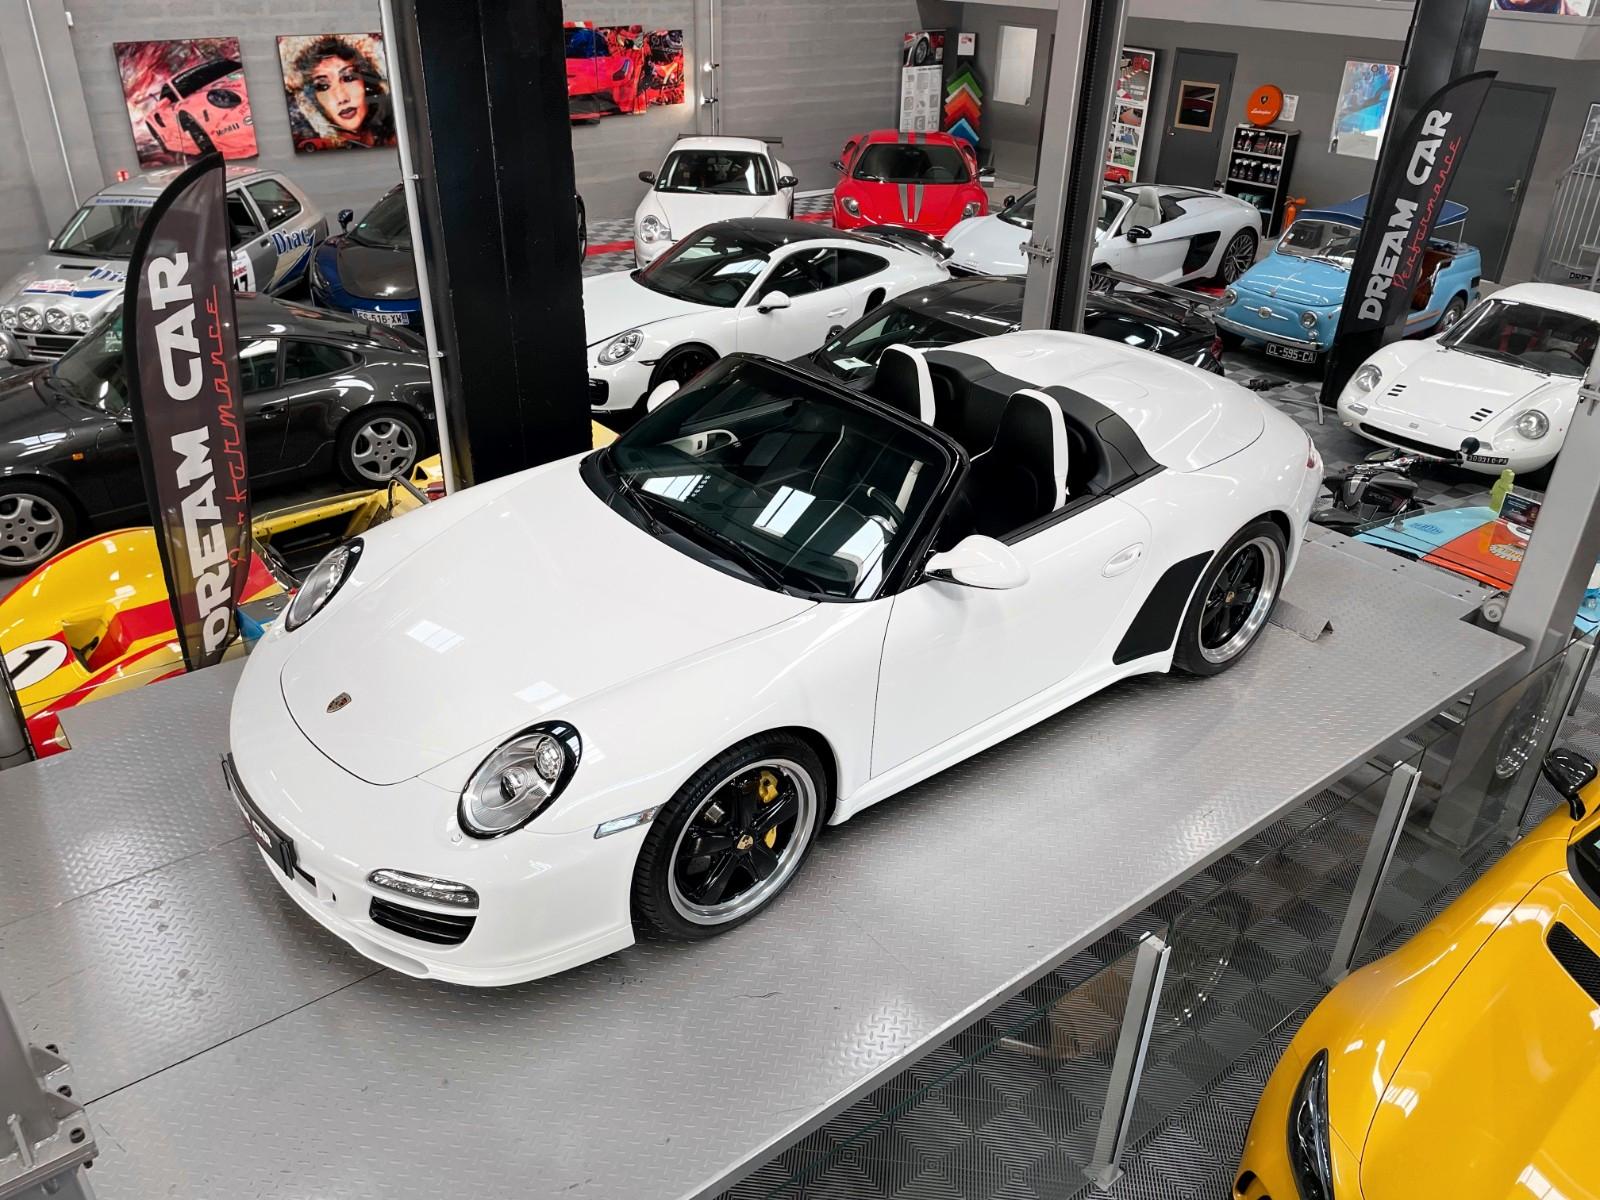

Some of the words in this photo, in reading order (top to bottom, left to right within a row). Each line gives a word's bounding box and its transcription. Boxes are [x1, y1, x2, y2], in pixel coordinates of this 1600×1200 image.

[271, 228, 311, 256] Diac
[1358, 198, 1419, 321] DREAM
[1406, 109, 1453, 185] CAR
[148, 252, 203, 400] CAR
[1269, 344, 1313, 362] CL-595-CA
[171, 425, 232, 656] DREAM
